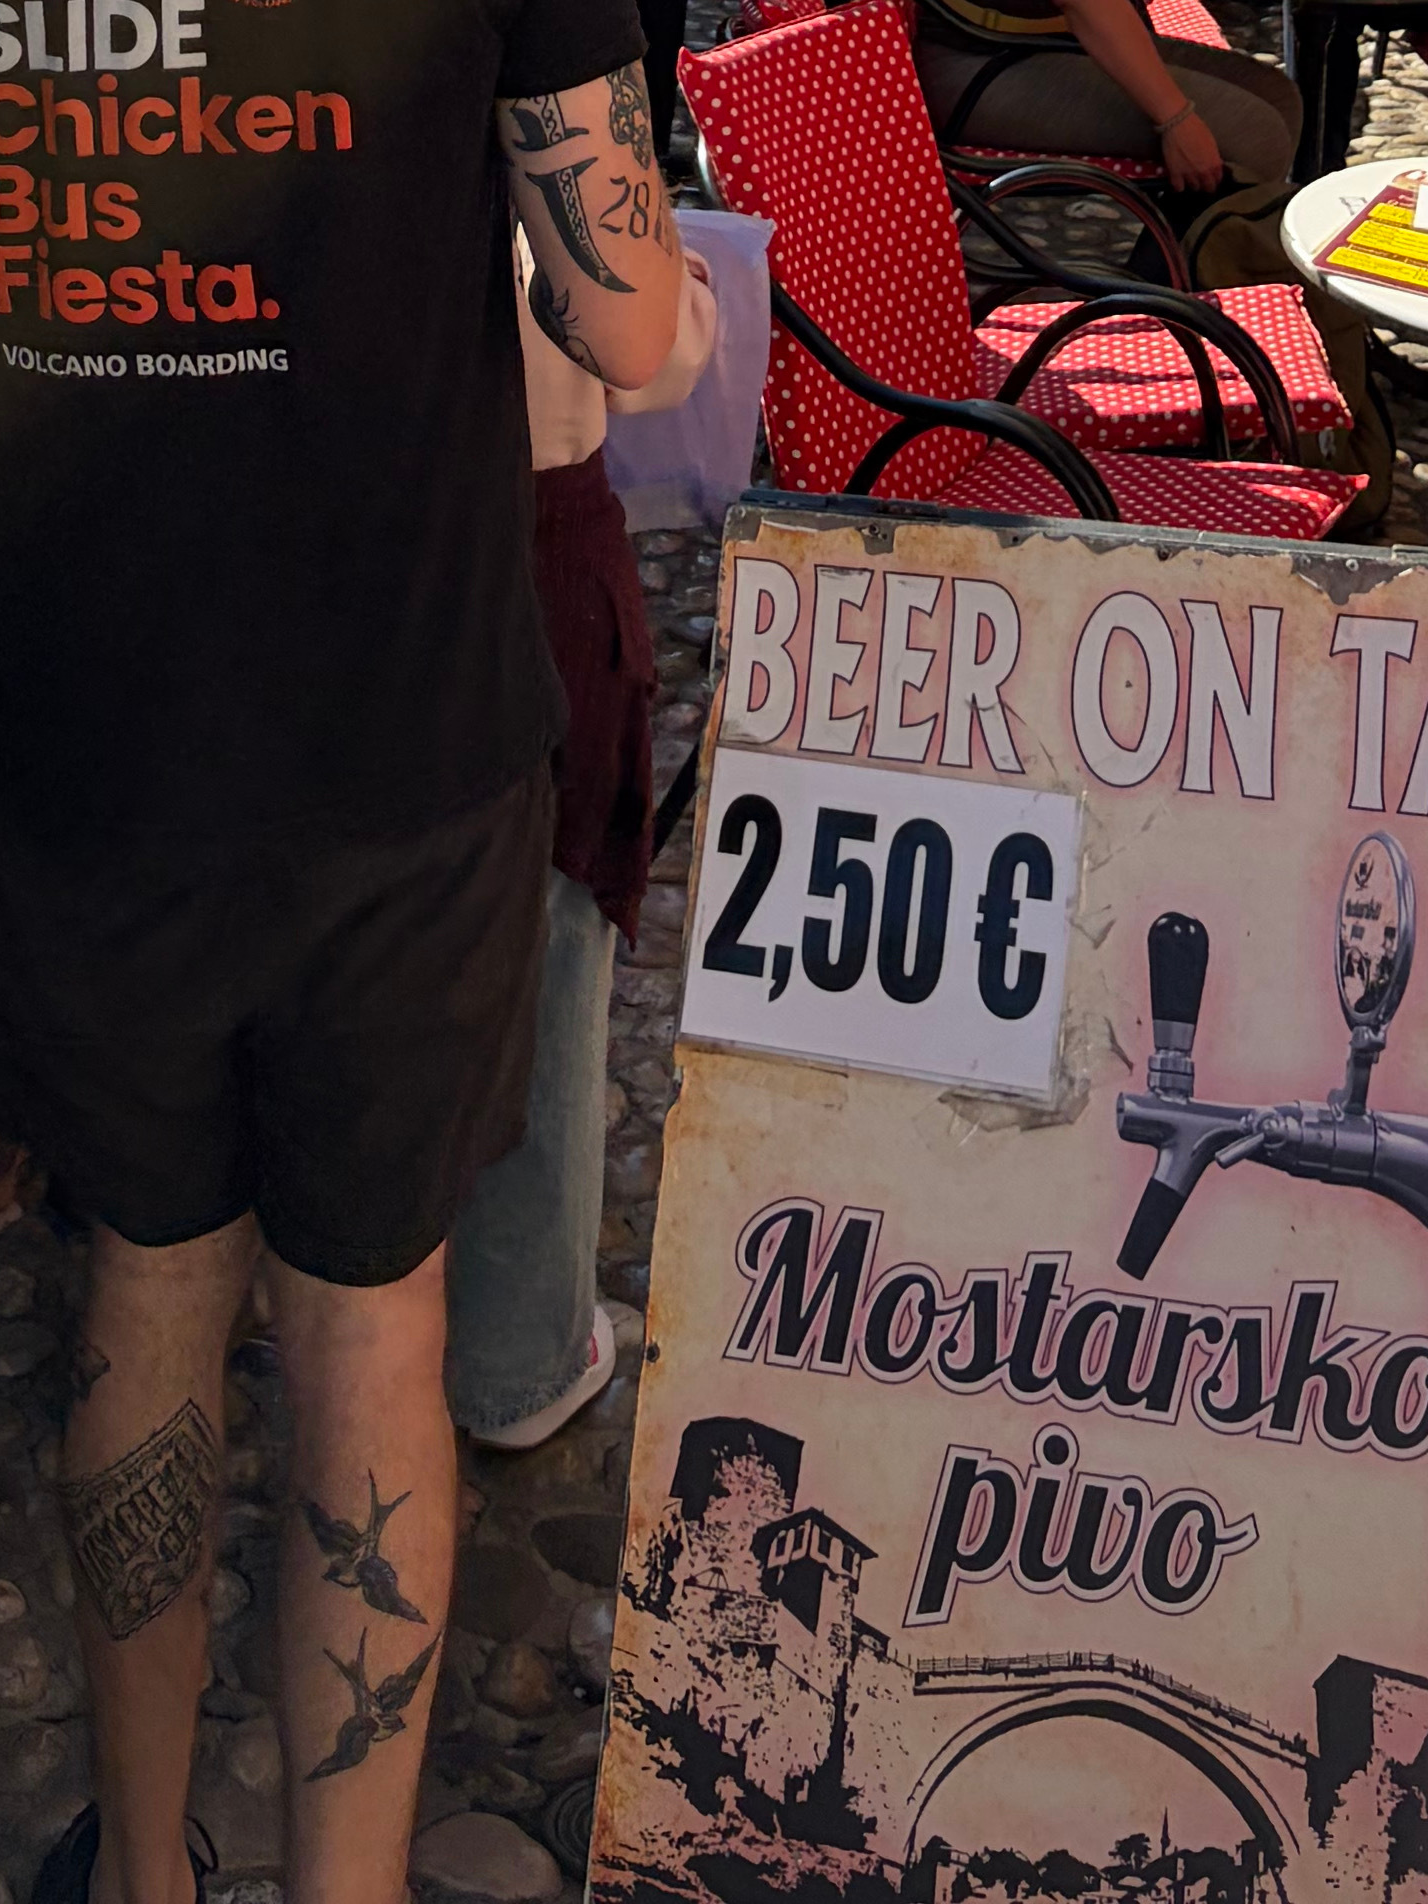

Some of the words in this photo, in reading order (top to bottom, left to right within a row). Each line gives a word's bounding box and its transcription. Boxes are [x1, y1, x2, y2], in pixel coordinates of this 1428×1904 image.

[598, 175, 651, 240] 28
[2, 343, 127, 378] VOLCANO
[136, 348, 289, 377] BOARDING
[722, 558, 1028, 775] BEER
[1070, 591, 1287, 800] ON
[702, 794, 950, 1004] 2,50
[974, 832, 1054, 1020] €
[903, 1422, 1260, 1629] pivo
